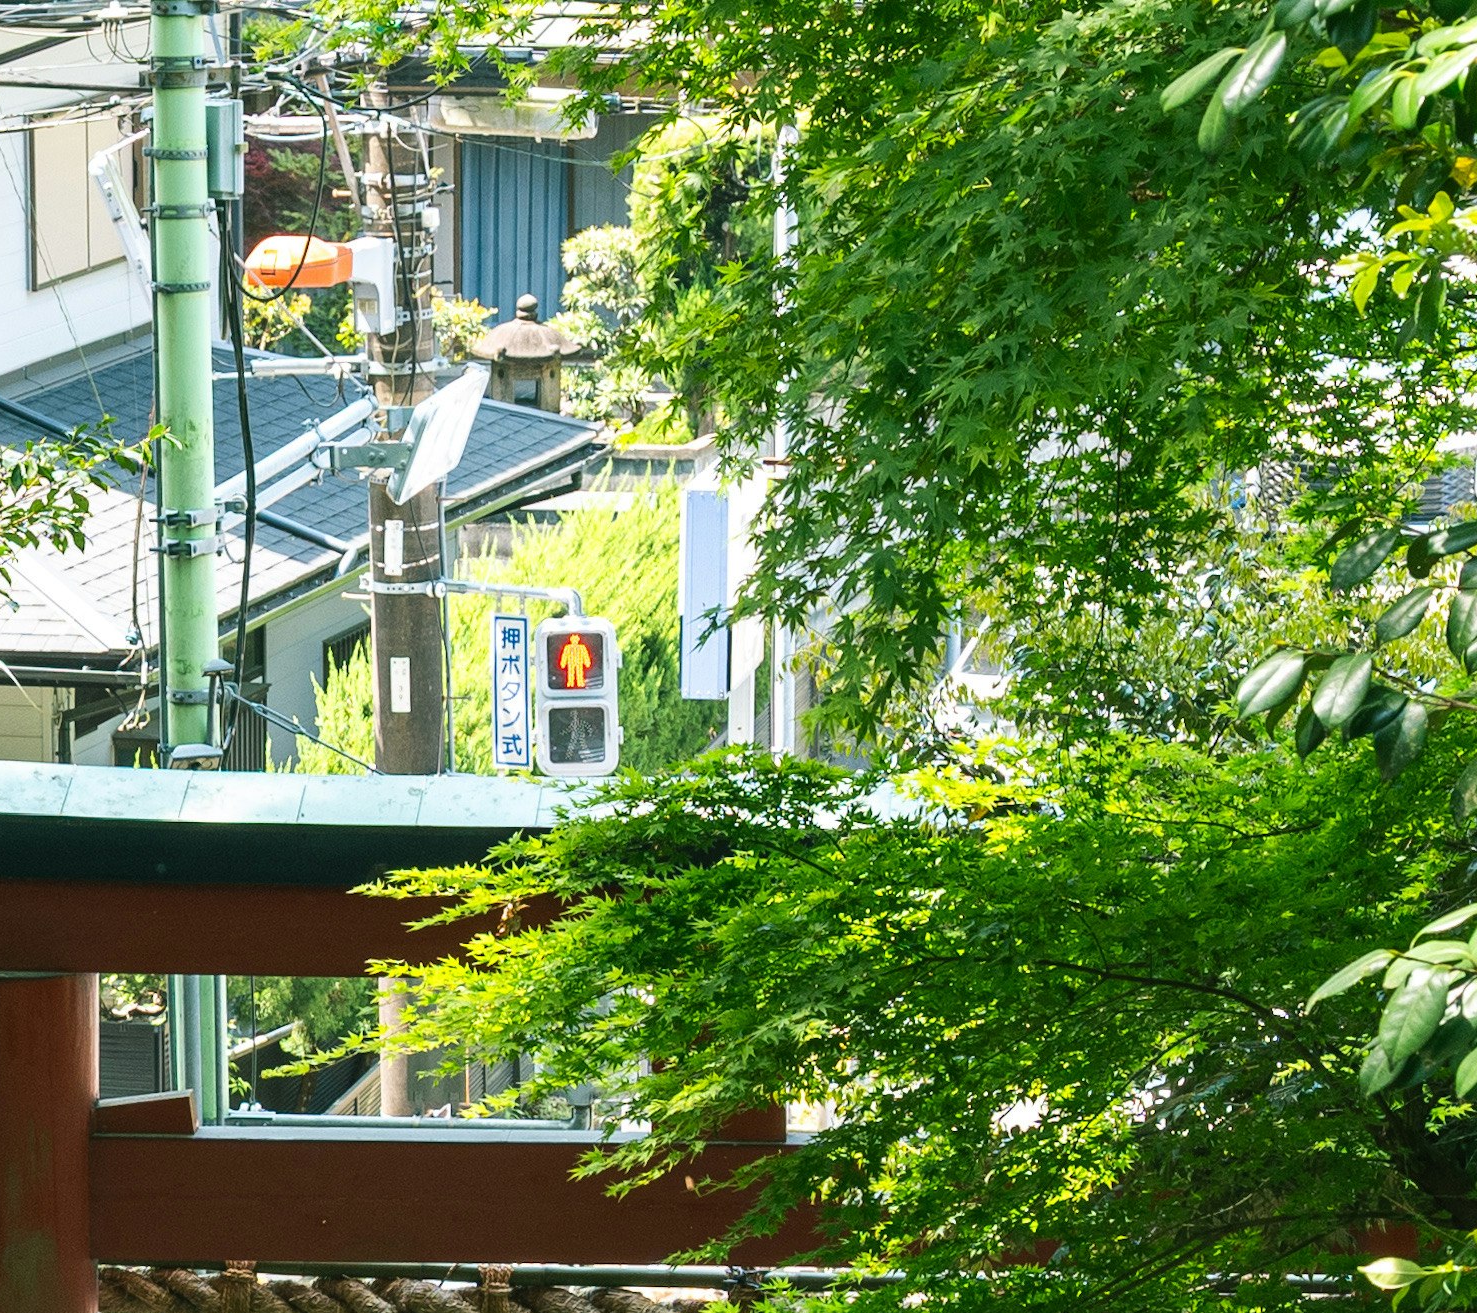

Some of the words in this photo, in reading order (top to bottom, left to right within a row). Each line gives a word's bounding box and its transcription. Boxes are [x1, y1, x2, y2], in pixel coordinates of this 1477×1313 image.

[501, 626, 523, 756] 押ボタン式
